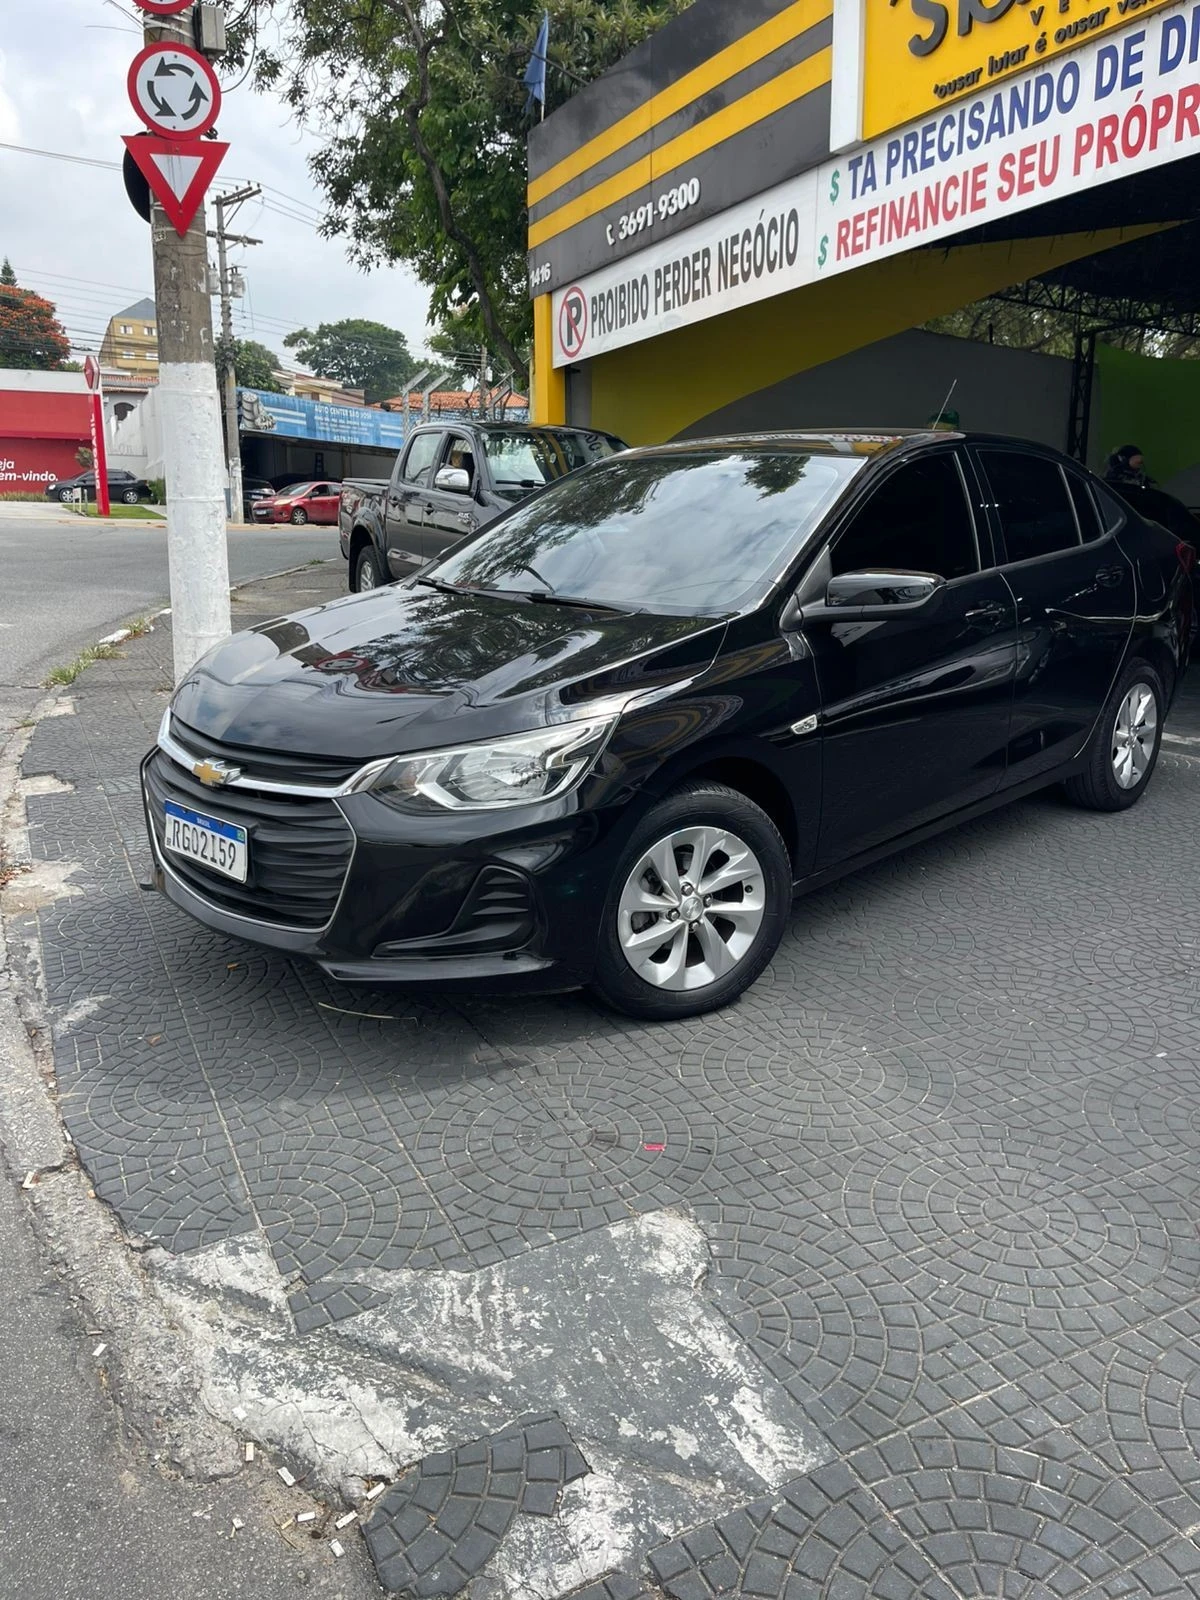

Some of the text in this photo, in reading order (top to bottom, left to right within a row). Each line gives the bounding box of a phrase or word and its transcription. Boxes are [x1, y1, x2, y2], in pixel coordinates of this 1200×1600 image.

[988, 45, 1029, 77] lutar
[1035, 31, 1048, 53] é
[1054, 7, 1110, 43] ousar
[848, 150, 876, 200] TA
[885, 61, 1081, 186] PRECISANDO
[1094, 29, 1146, 101] DE
[618, 177, 701, 241] 3691-9300
[836, 162, 988, 261] REFINANCIE
[997, 134, 1061, 203] SEU
[1073, 83, 1200, 177] PRÓPR
[530, 262, 551, 288] 1416
[591, 274, 649, 339] PROIBIDO
[654, 246, 712, 316] PERDER
[717, 208, 799, 293] NEGÓCIO
[90, 413, 101, 489] DROGASIL
